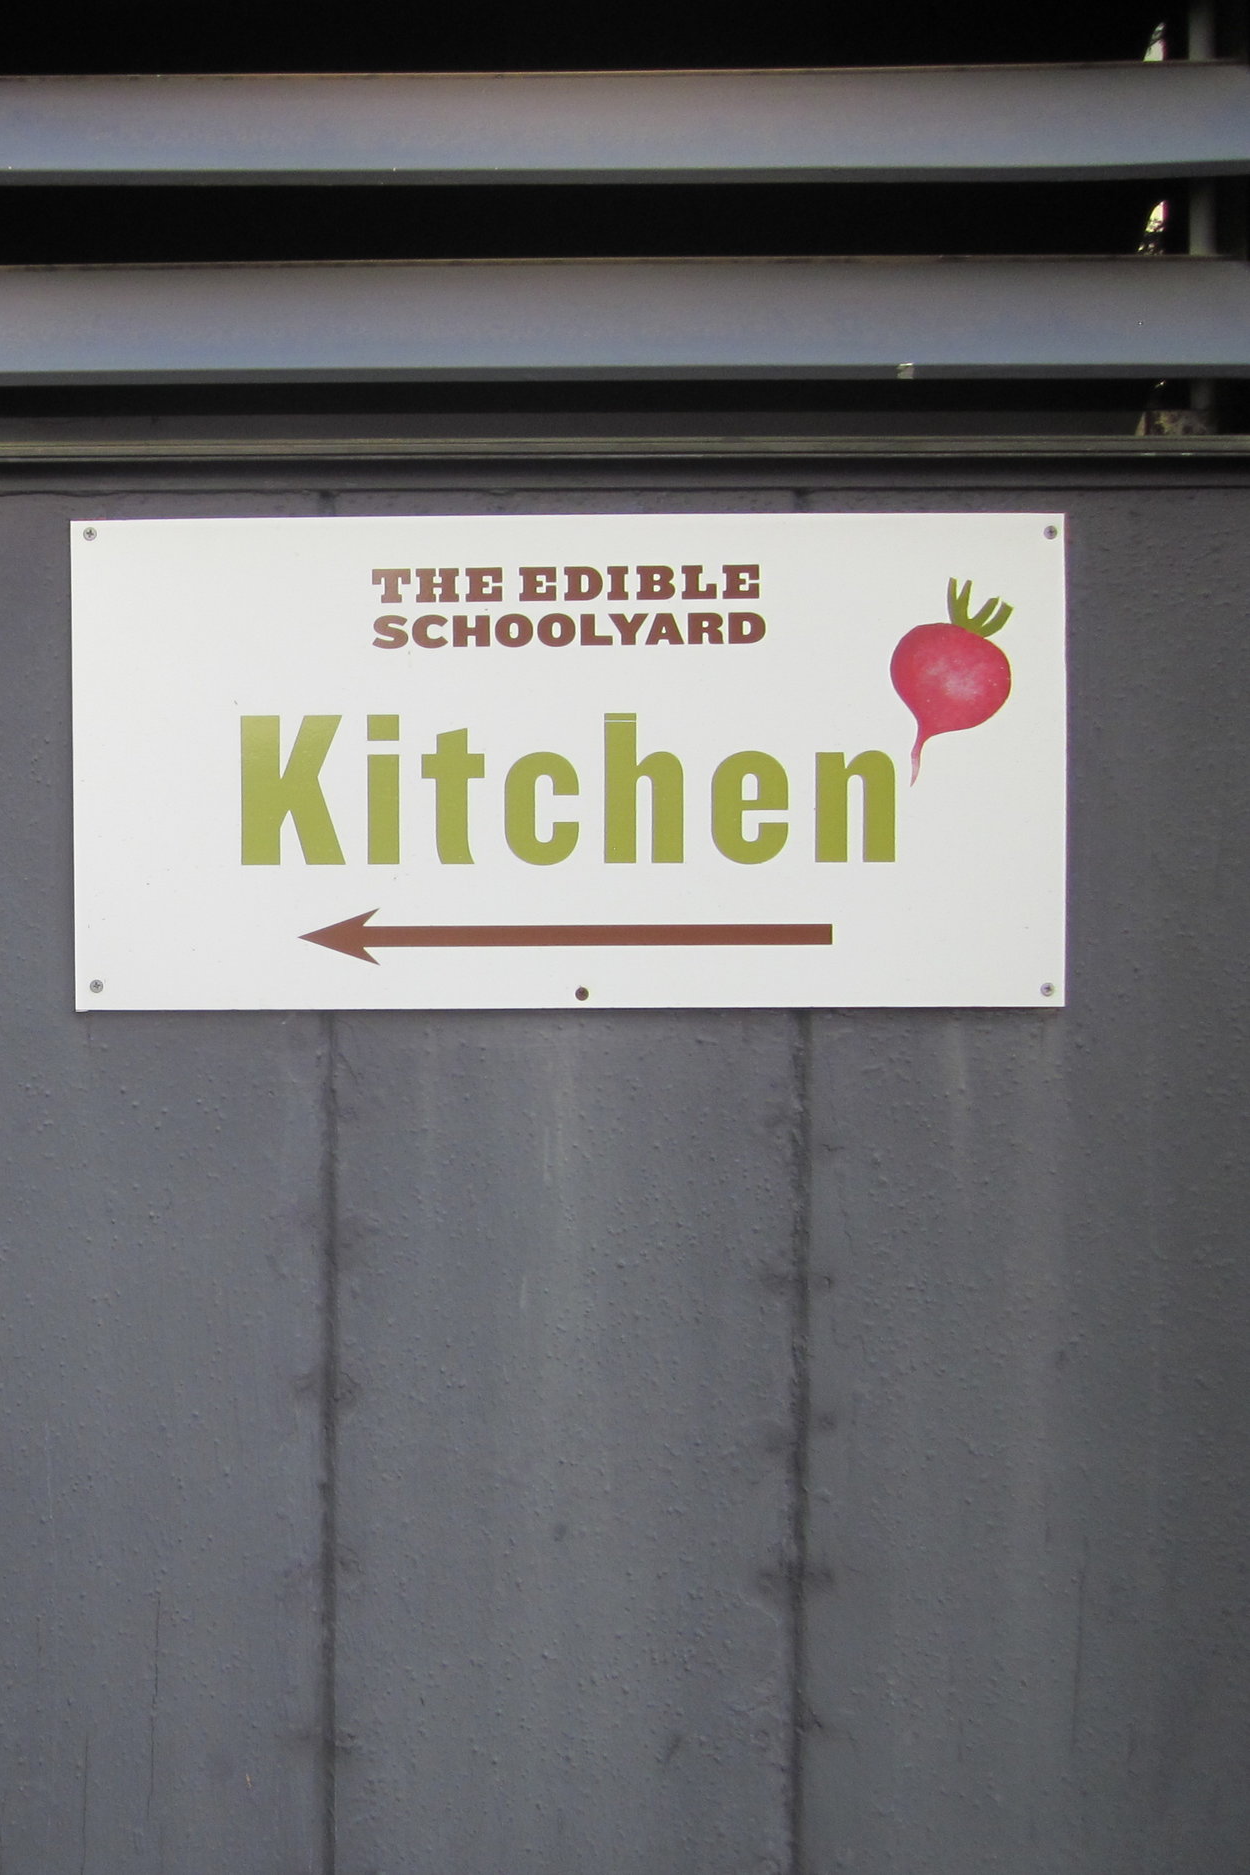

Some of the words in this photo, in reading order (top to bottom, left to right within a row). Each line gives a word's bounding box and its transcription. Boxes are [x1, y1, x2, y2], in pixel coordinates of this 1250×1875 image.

[371, 566, 503, 603] THE
[518, 563, 761, 602] EDIBLE
[372, 611, 767, 649] SCHOOLYARD
[240, 712, 897, 866] Kitchen
